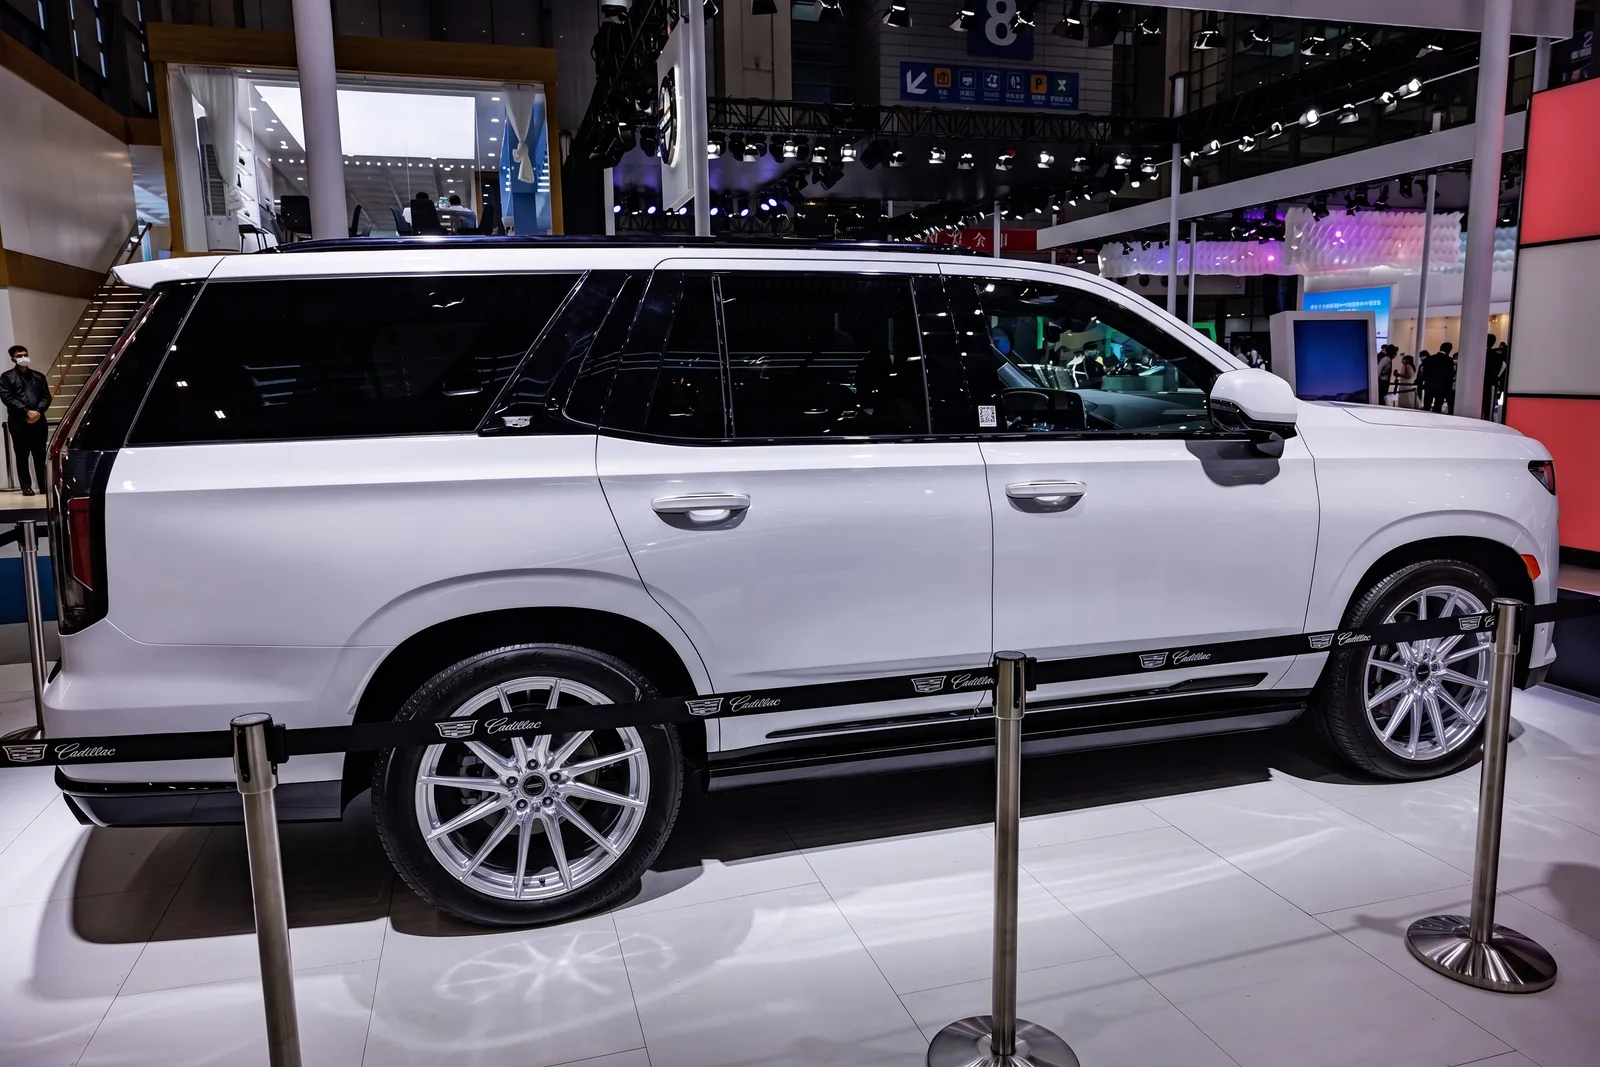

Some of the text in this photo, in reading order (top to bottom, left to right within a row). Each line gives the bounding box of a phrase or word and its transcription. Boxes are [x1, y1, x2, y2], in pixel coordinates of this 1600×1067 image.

[985, 0, 1017, 46] 8
[1338, 632, 1372, 646] Cadillac
[1172, 650, 1211, 666] Cadillac
[730, 695, 781, 713] Cadillac
[484, 717, 542, 735] Cadillac
[54, 743, 116, 760] Cadillac
